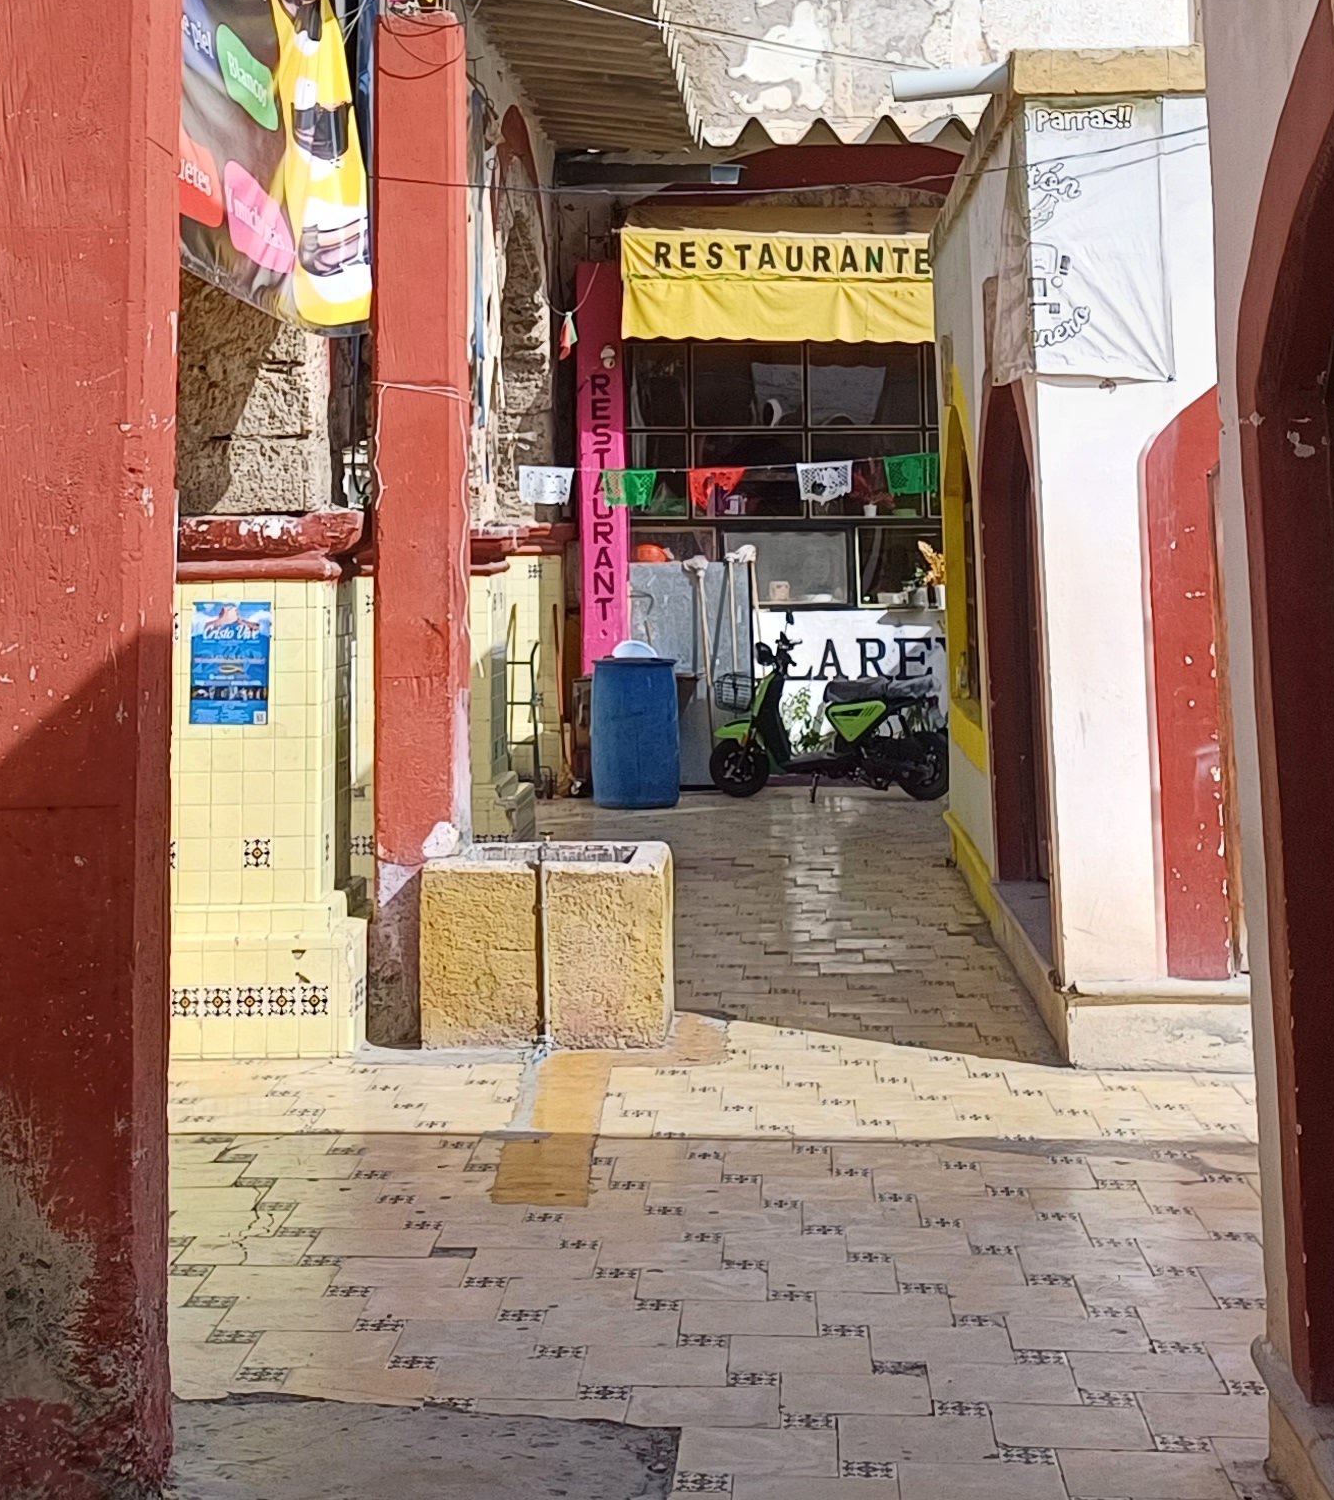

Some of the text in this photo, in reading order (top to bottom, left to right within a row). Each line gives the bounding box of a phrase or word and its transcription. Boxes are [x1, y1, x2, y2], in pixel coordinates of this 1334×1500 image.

[190, 21, 214, 59] piel
[1035, 104, 1134, 132] Parras!!
[654, 241, 931, 275] RESTAURANTE
[202, 624, 261, 640] Cristo Vive
[855, 636, 947, 681] RE
